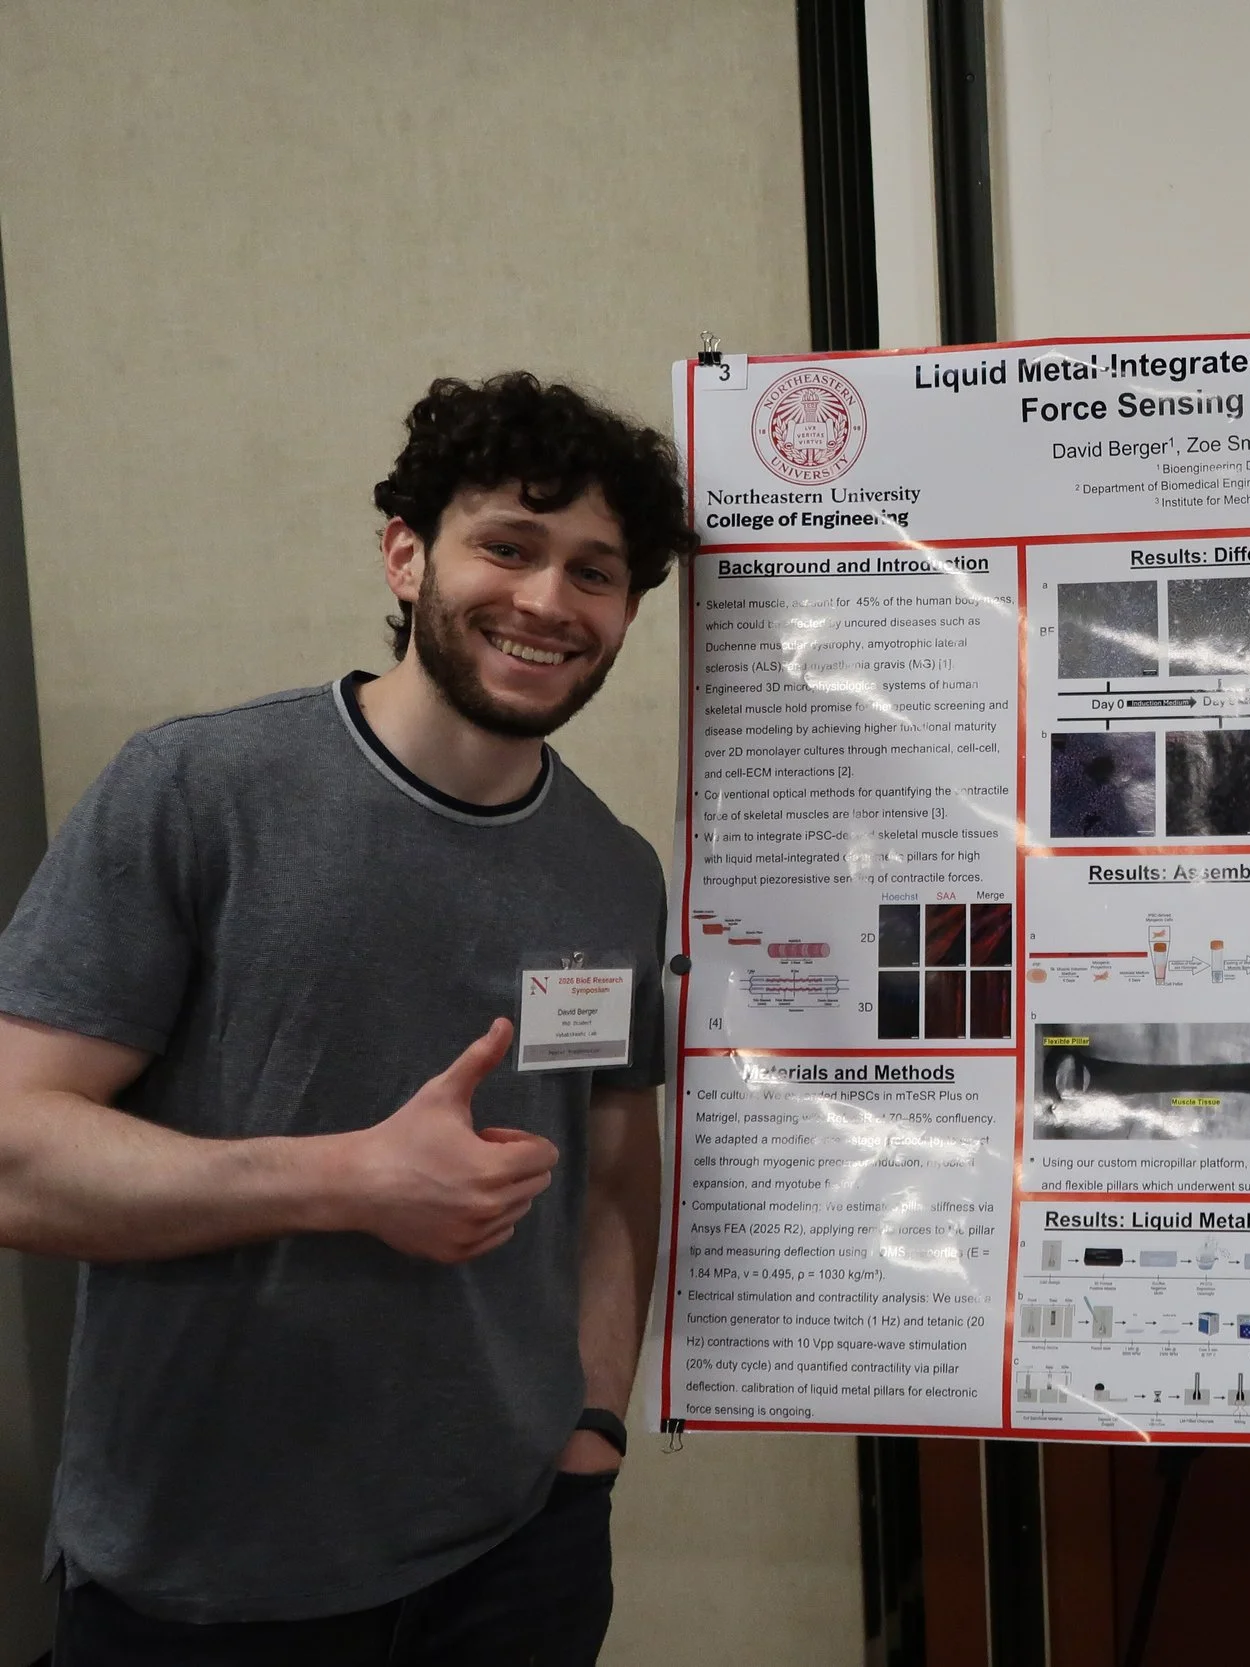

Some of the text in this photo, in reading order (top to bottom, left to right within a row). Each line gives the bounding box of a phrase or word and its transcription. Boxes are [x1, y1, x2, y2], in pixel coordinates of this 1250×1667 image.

[719, 364, 731, 381] 3
[915, 359, 1006, 393] Liquid
[764, 374, 856, 409] NORTHEASTERN
[1021, 397, 1107, 422] Force
[1117, 388, 1243, 419] Sensing
[1052, 441, 1102, 459] David
[1186, 436, 1221, 452] Zoe
[771, 455, 849, 479] UNIVERSITY
[1162, 460, 1242, 475] Bioengineering
[706, 485, 920, 505] Northeastern University
[1082, 481, 1145, 496] Department
[1147, 480, 1159, 492] of
[1159, 478, 1219, 491] Biomedical
[1161, 496, 1203, 507] Institute
[1206, 495, 1221, 505] for
[706, 509, 908, 530] College of Engineering
[1131, 548, 1206, 565] Results:
[718, 560, 830, 576] Background
[837, 558, 869, 573] and
[1091, 699, 1125, 713] Day 0
[704, 765, 854, 778] and cell-ECM interactions [2].
[1089, 864, 1165, 882] Results:
[882, 890, 1005, 901] Hoechst SAA Merge
[860, 933, 875, 943] 2D
[577, 1008, 598, 1016] Berger
[858, 1003, 873, 1012] 3D
[709, 1018, 722, 1029] [4]
[834, 1065, 868, 1080] and
[874, 1064, 954, 1081] Methods
[1045, 1210, 1124, 1229] Results:
[1132, 1211, 1192, 1231] Liquid
[686, 1402, 814, 1420] force sensing is ongoing.
